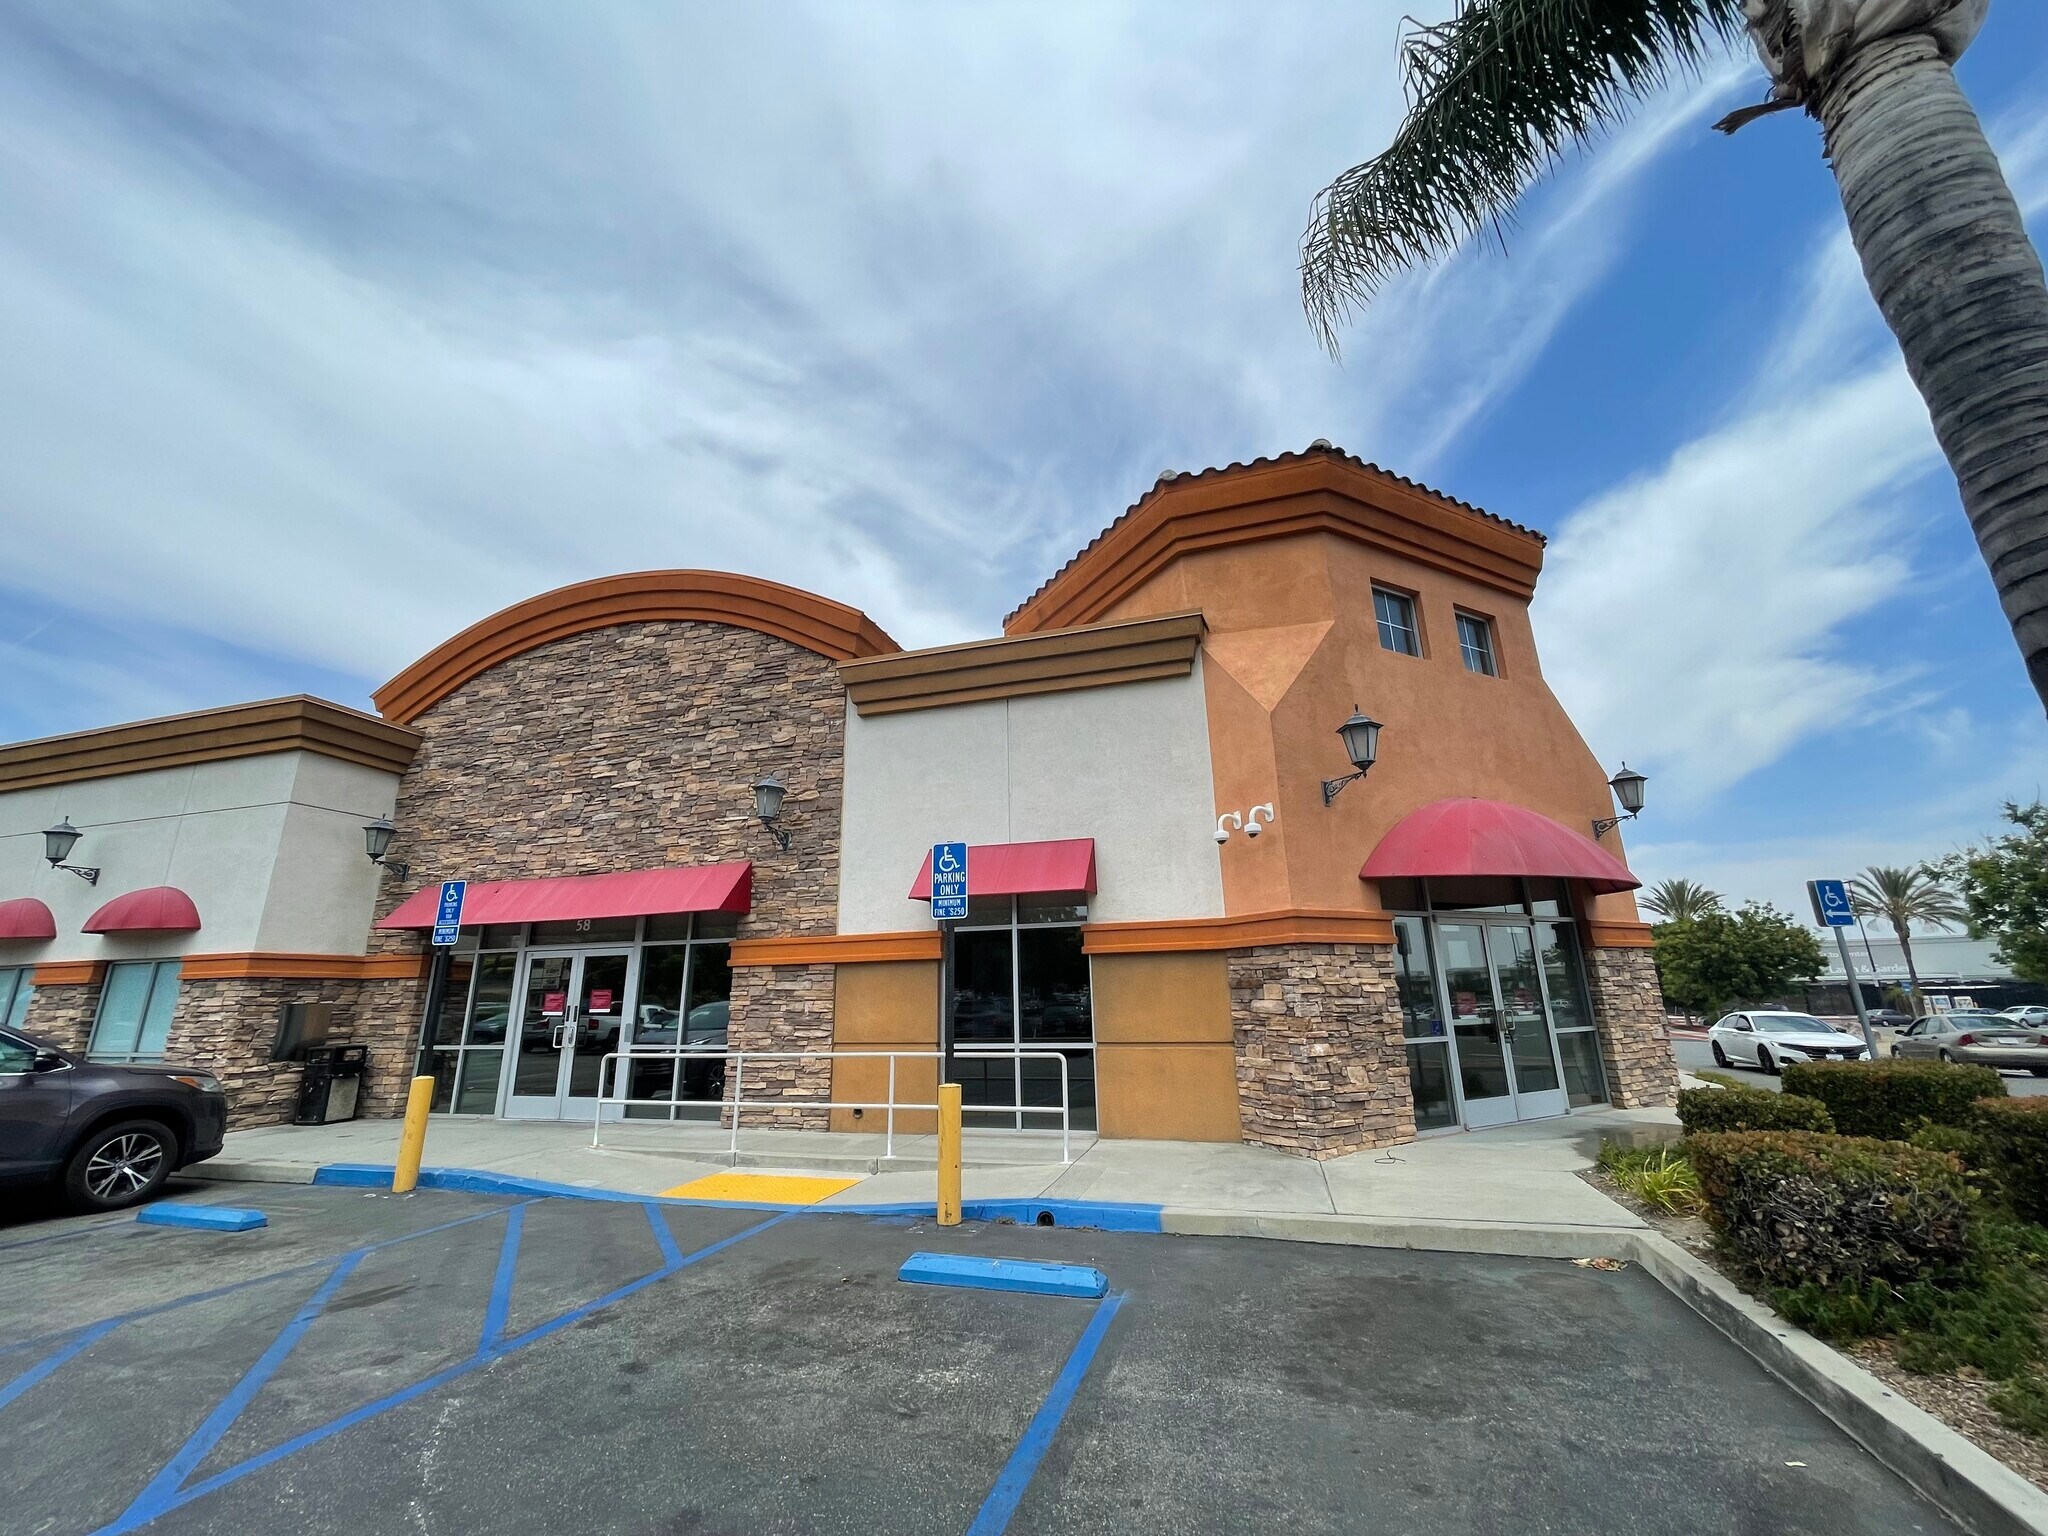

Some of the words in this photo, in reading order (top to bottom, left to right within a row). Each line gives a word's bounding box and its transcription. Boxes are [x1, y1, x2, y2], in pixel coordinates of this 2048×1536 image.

[934, 872, 965, 884] PARKING
[940, 884, 959, 895] ONLY
[938, 899, 961, 907] MINIMUM
[934, 908, 946, 916] FINE
[576, 919, 591, 931] 58
[1861, 964, 1870, 973] &
